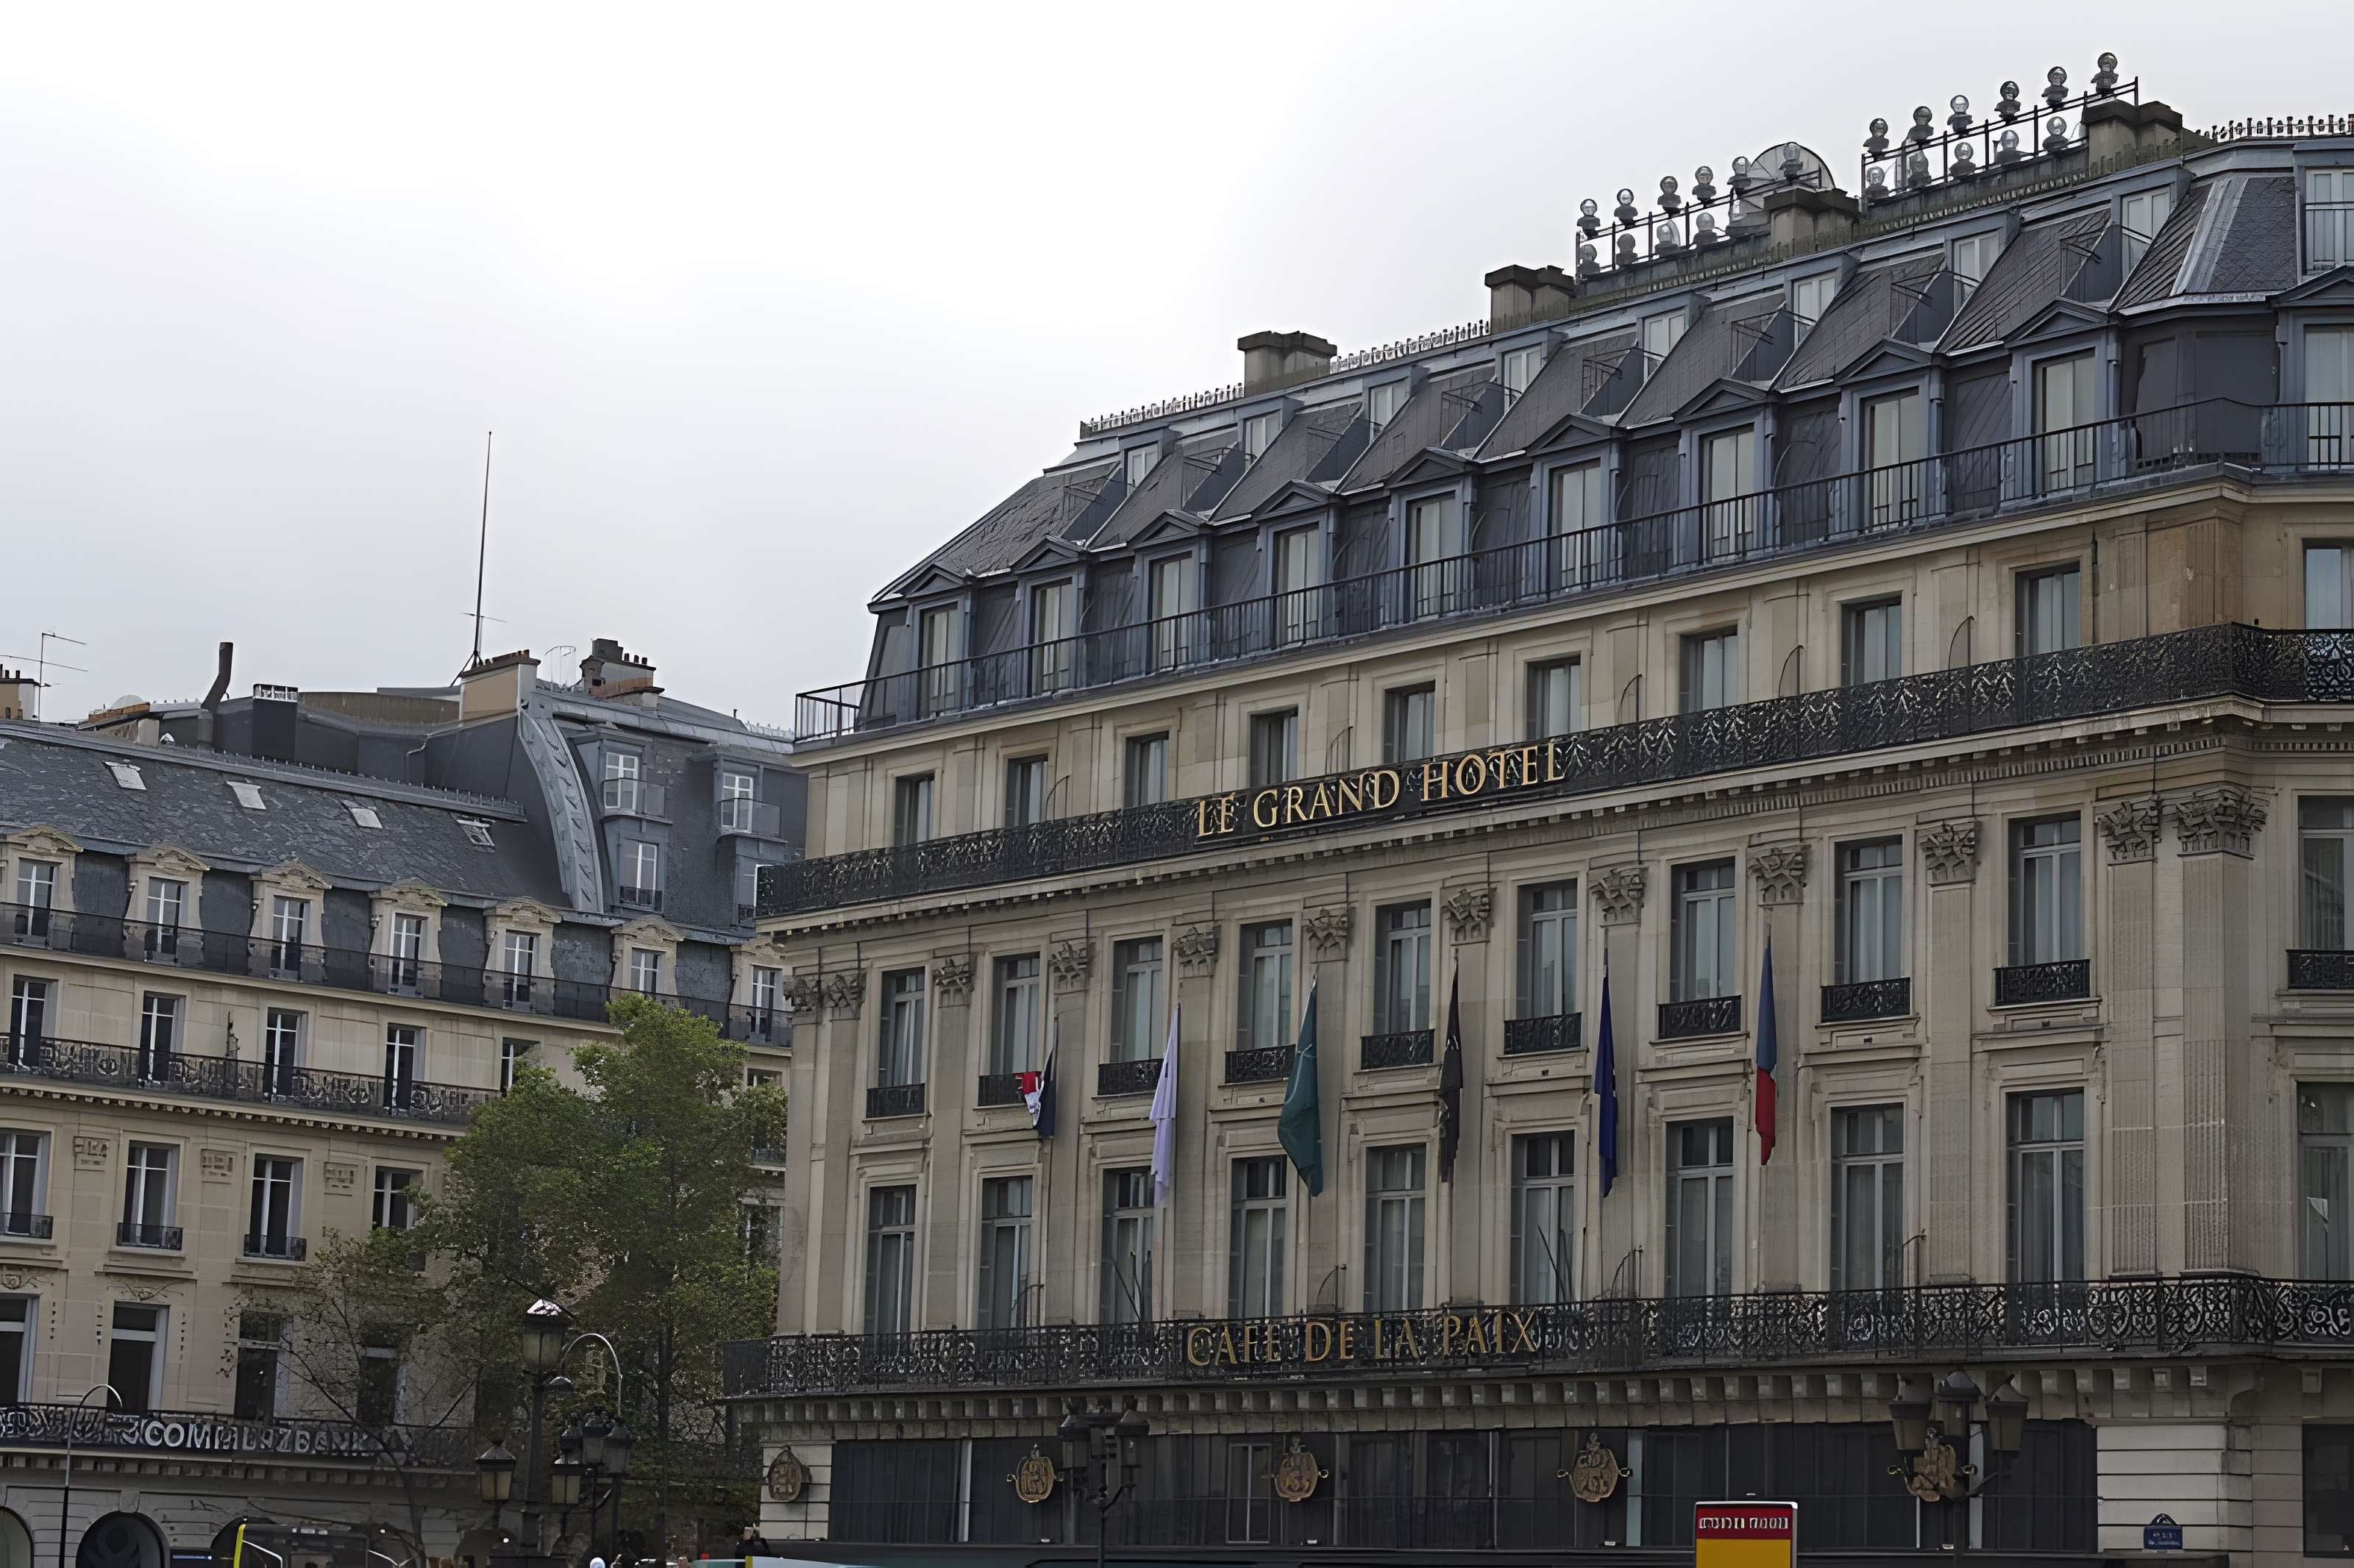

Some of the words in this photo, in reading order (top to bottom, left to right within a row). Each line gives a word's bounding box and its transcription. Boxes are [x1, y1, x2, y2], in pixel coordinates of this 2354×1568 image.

[1198, 793, 1236, 837] LE
[1254, 770, 1400, 827] GRAND
[1420, 742, 1565, 802] HOTEL
[1304, 1319, 1354, 1362] DE
[1374, 1317, 1421, 1361] LA
[1443, 1308, 1539, 1355] PAIX
